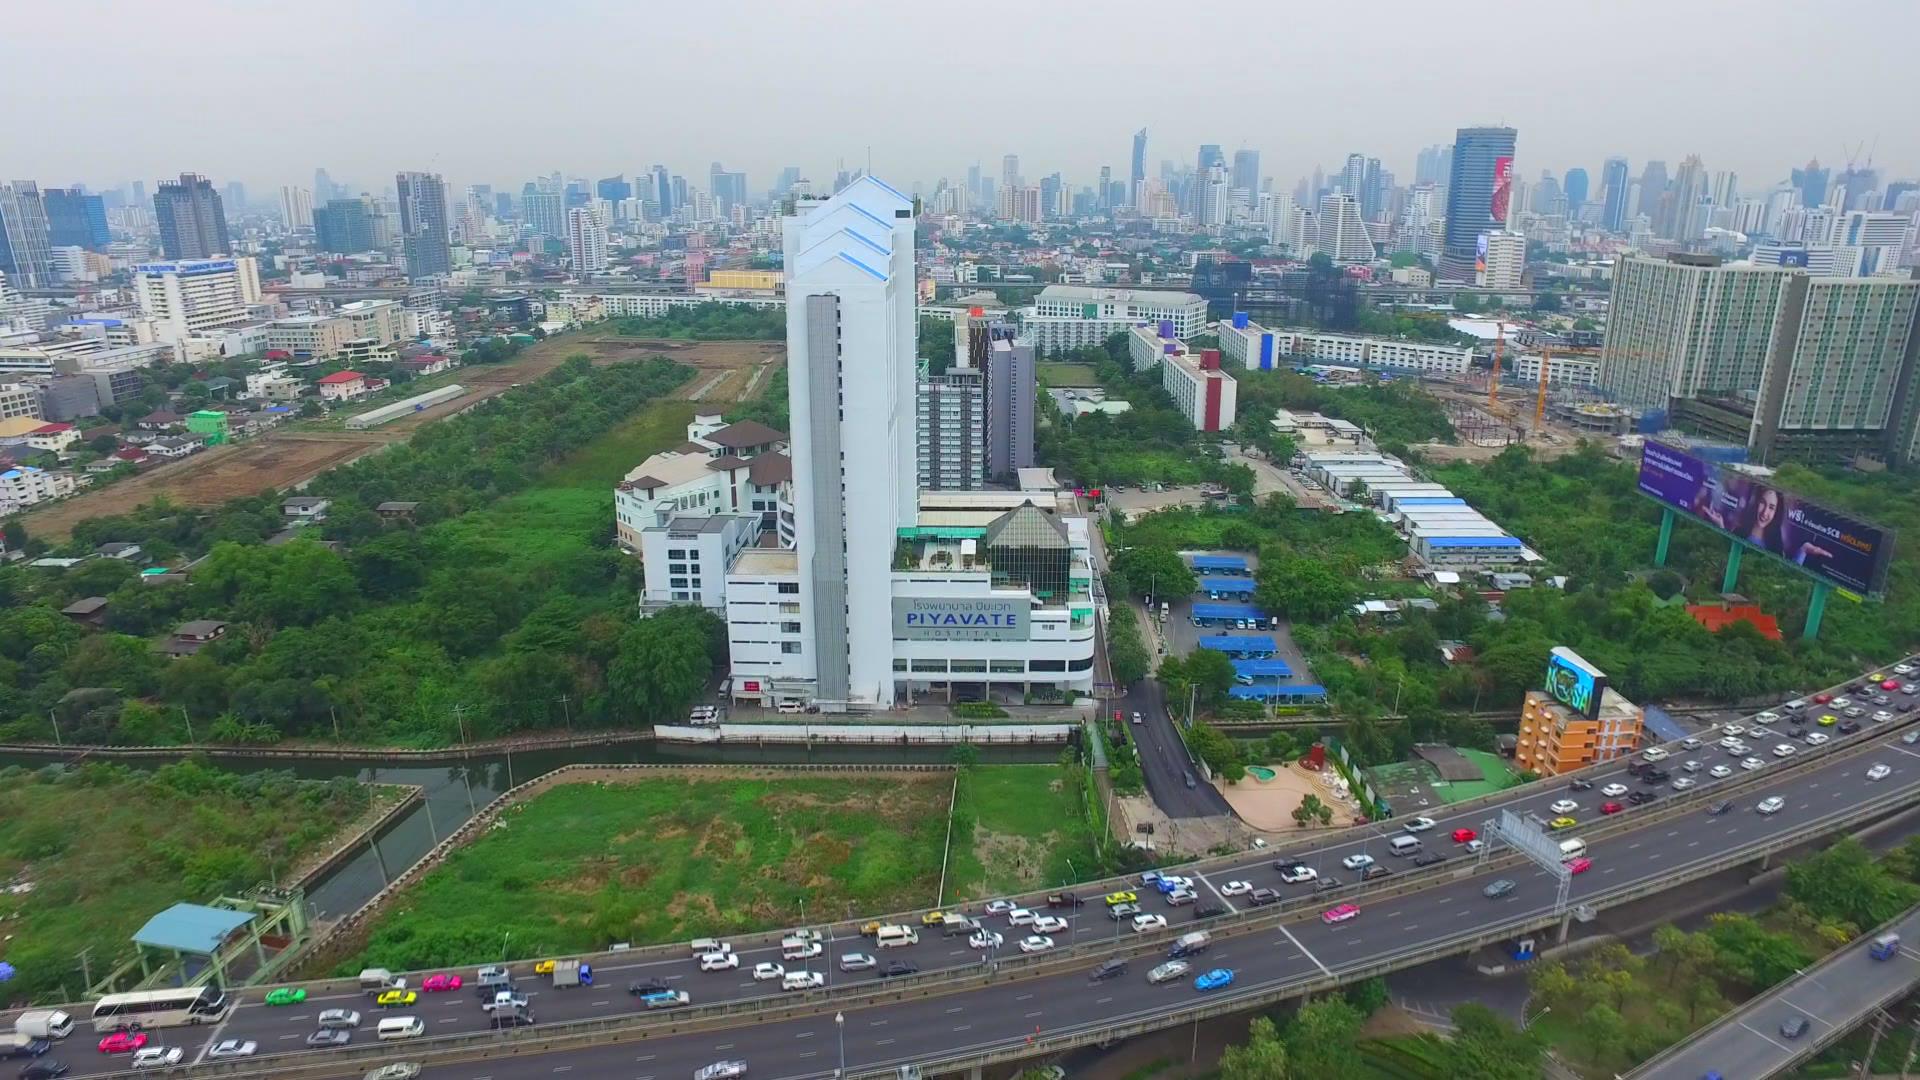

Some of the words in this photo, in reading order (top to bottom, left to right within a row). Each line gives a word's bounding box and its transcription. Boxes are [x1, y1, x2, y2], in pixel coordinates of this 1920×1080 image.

[913, 600, 973, 611] โรงพยาบาล
[907, 613, 1016, 625] PIYAVATE
[924, 630, 1000, 638] HOSPITAL
